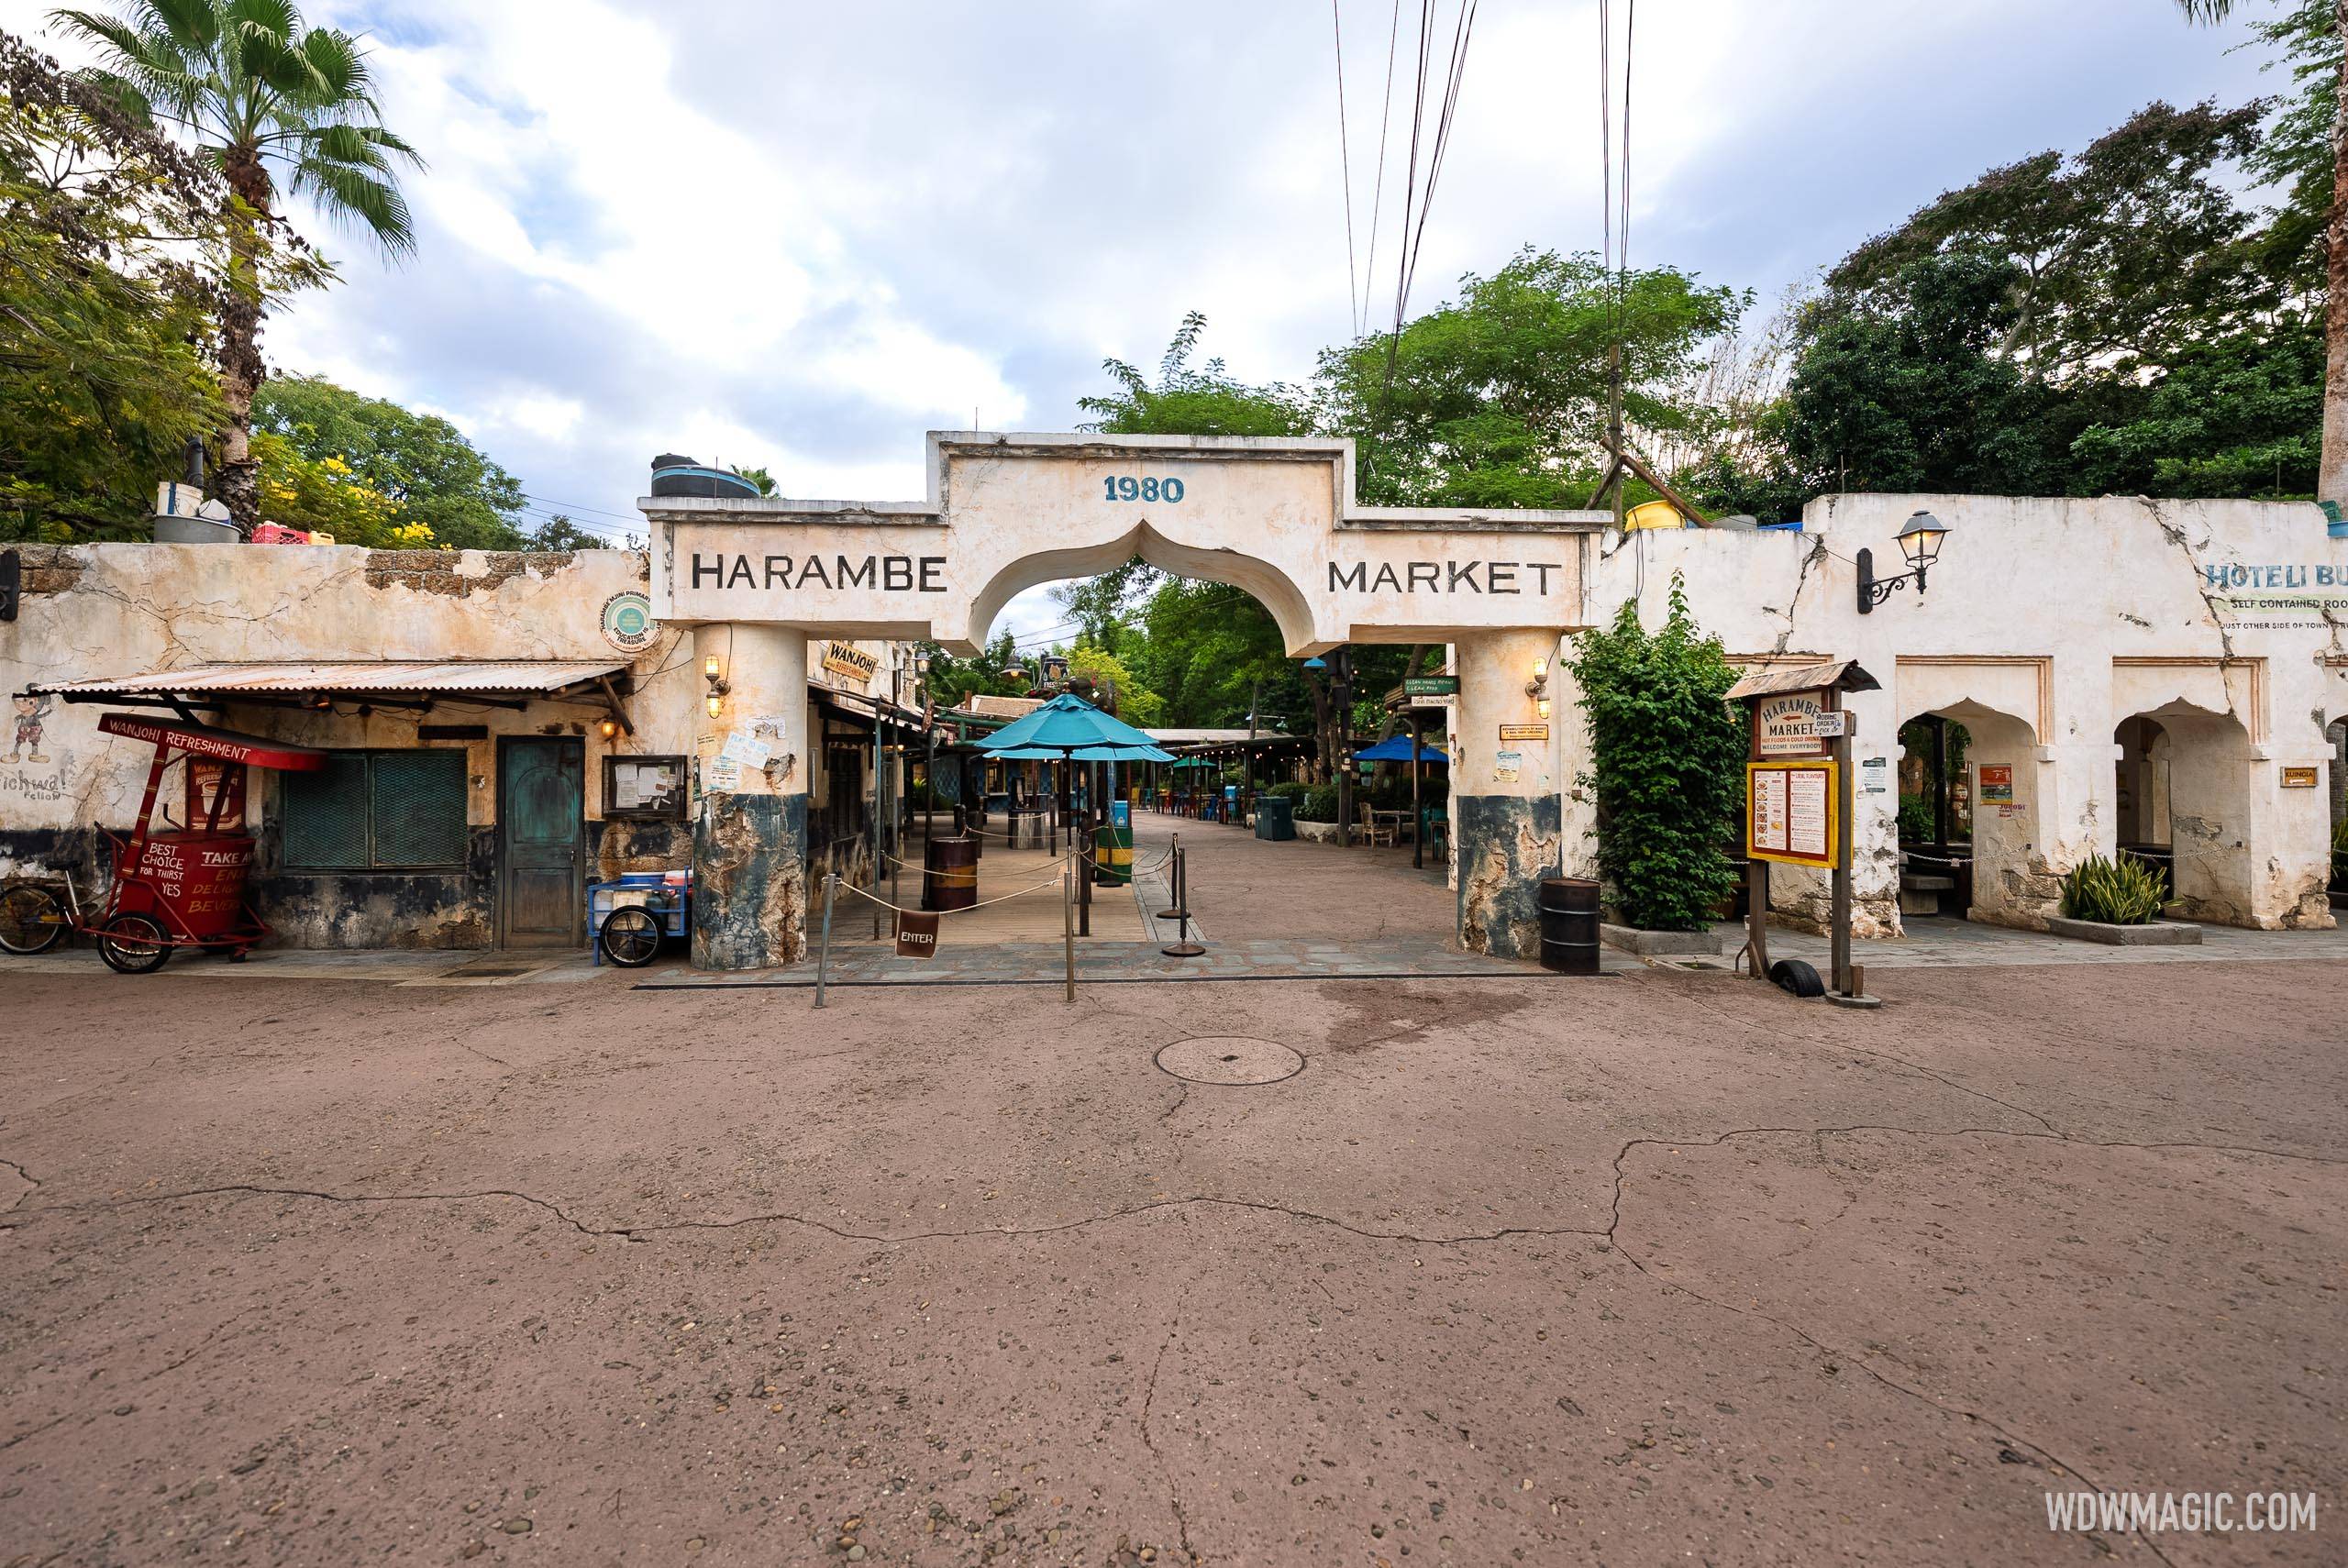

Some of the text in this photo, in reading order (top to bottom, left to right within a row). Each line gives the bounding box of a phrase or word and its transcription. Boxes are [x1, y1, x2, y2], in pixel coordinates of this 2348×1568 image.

[1104, 476, 1184, 503] 1980
[692, 554, 947, 591] HARAMBE
[1328, 561, 1562, 595] MARKET
[2206, 564, 2307, 588] HOTELI
[2232, 601, 2255, 609] SELF
[2259, 600, 2320, 609] CONTAINED
[614, 627, 644, 640] EDUCATION
[617, 636, 647, 645] TREASURE
[830, 643, 876, 674] WANJOHI
[1763, 699, 1822, 723] HARAMBE
[1769, 723, 1814, 736] MARKET
[109, 719, 251, 761] WANJOHI REFRESHMENT
[149, 843, 179, 856] BEST
[141, 854, 184, 870] CHOICE
[202, 852, 239, 864] TAKE
[139, 867, 153, 876] FOR
[161, 882, 181, 898] YES
[901, 932, 934, 944] ENTER
